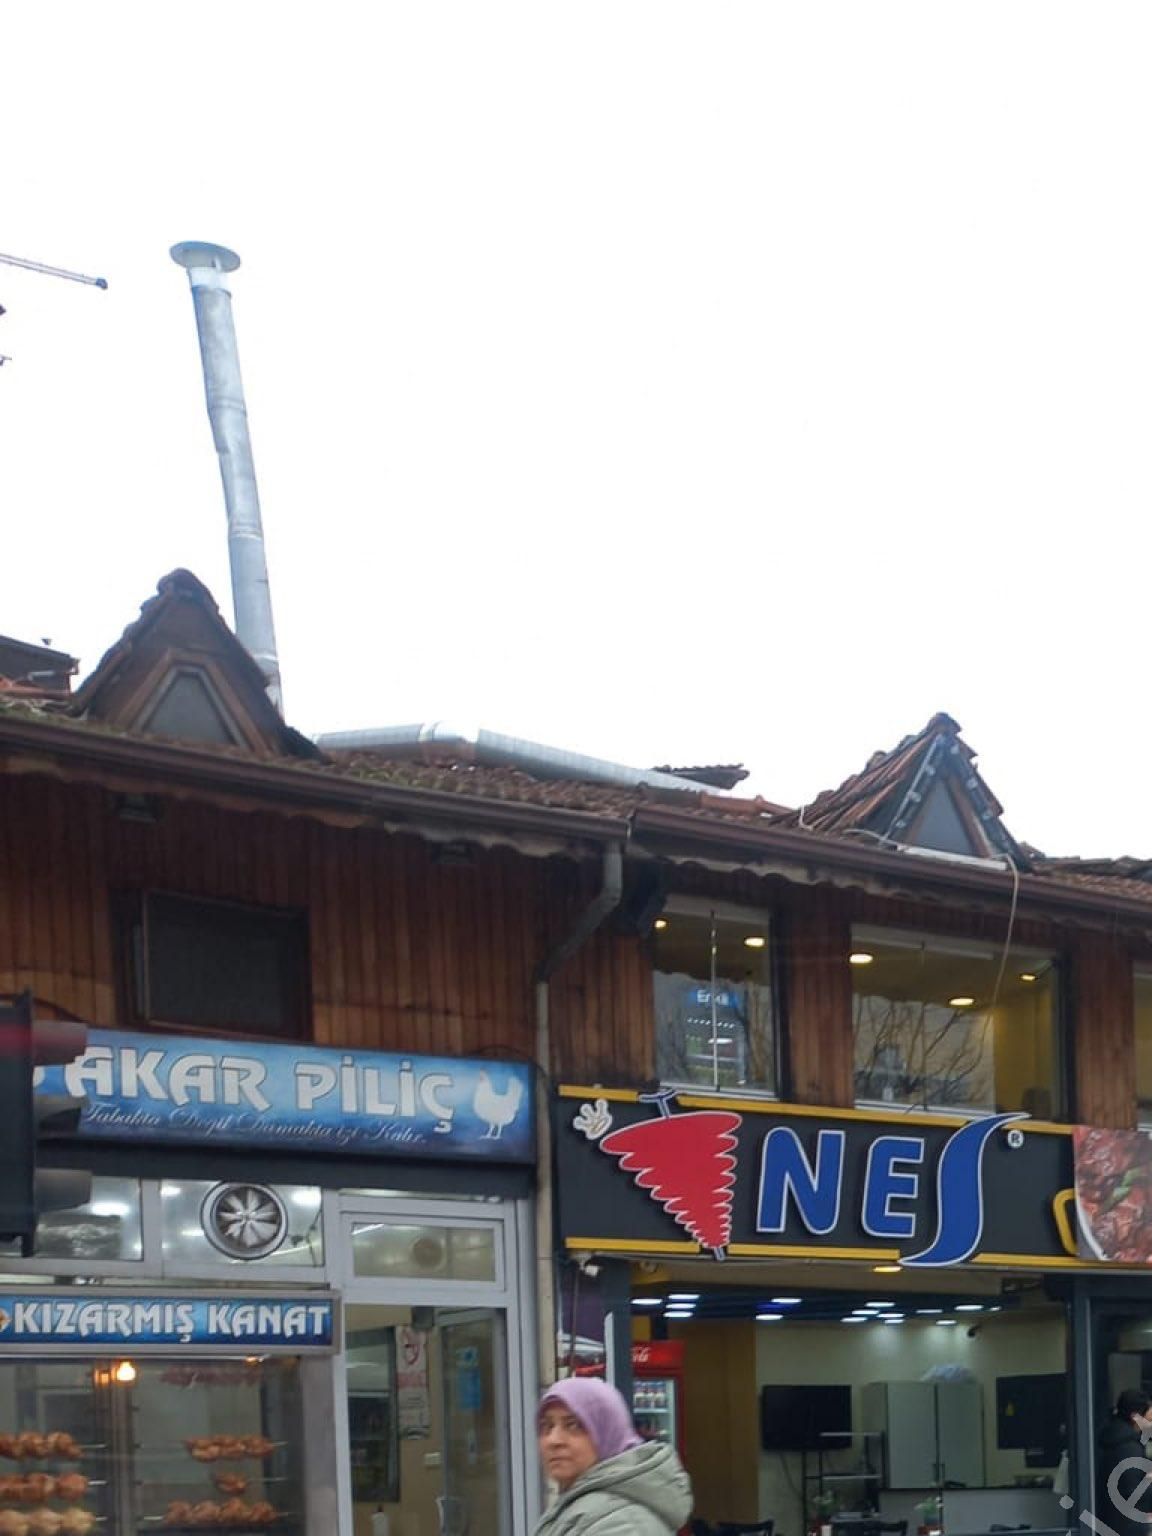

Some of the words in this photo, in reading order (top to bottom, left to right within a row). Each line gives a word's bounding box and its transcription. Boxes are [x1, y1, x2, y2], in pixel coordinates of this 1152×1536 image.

[64, 1046, 272, 1111] AKAR
[294, 1055, 455, 1134] PİLİÇ
[13, 1302, 194, 1343] KIZARMIŞ
[207, 1304, 330, 1338] KANAT
